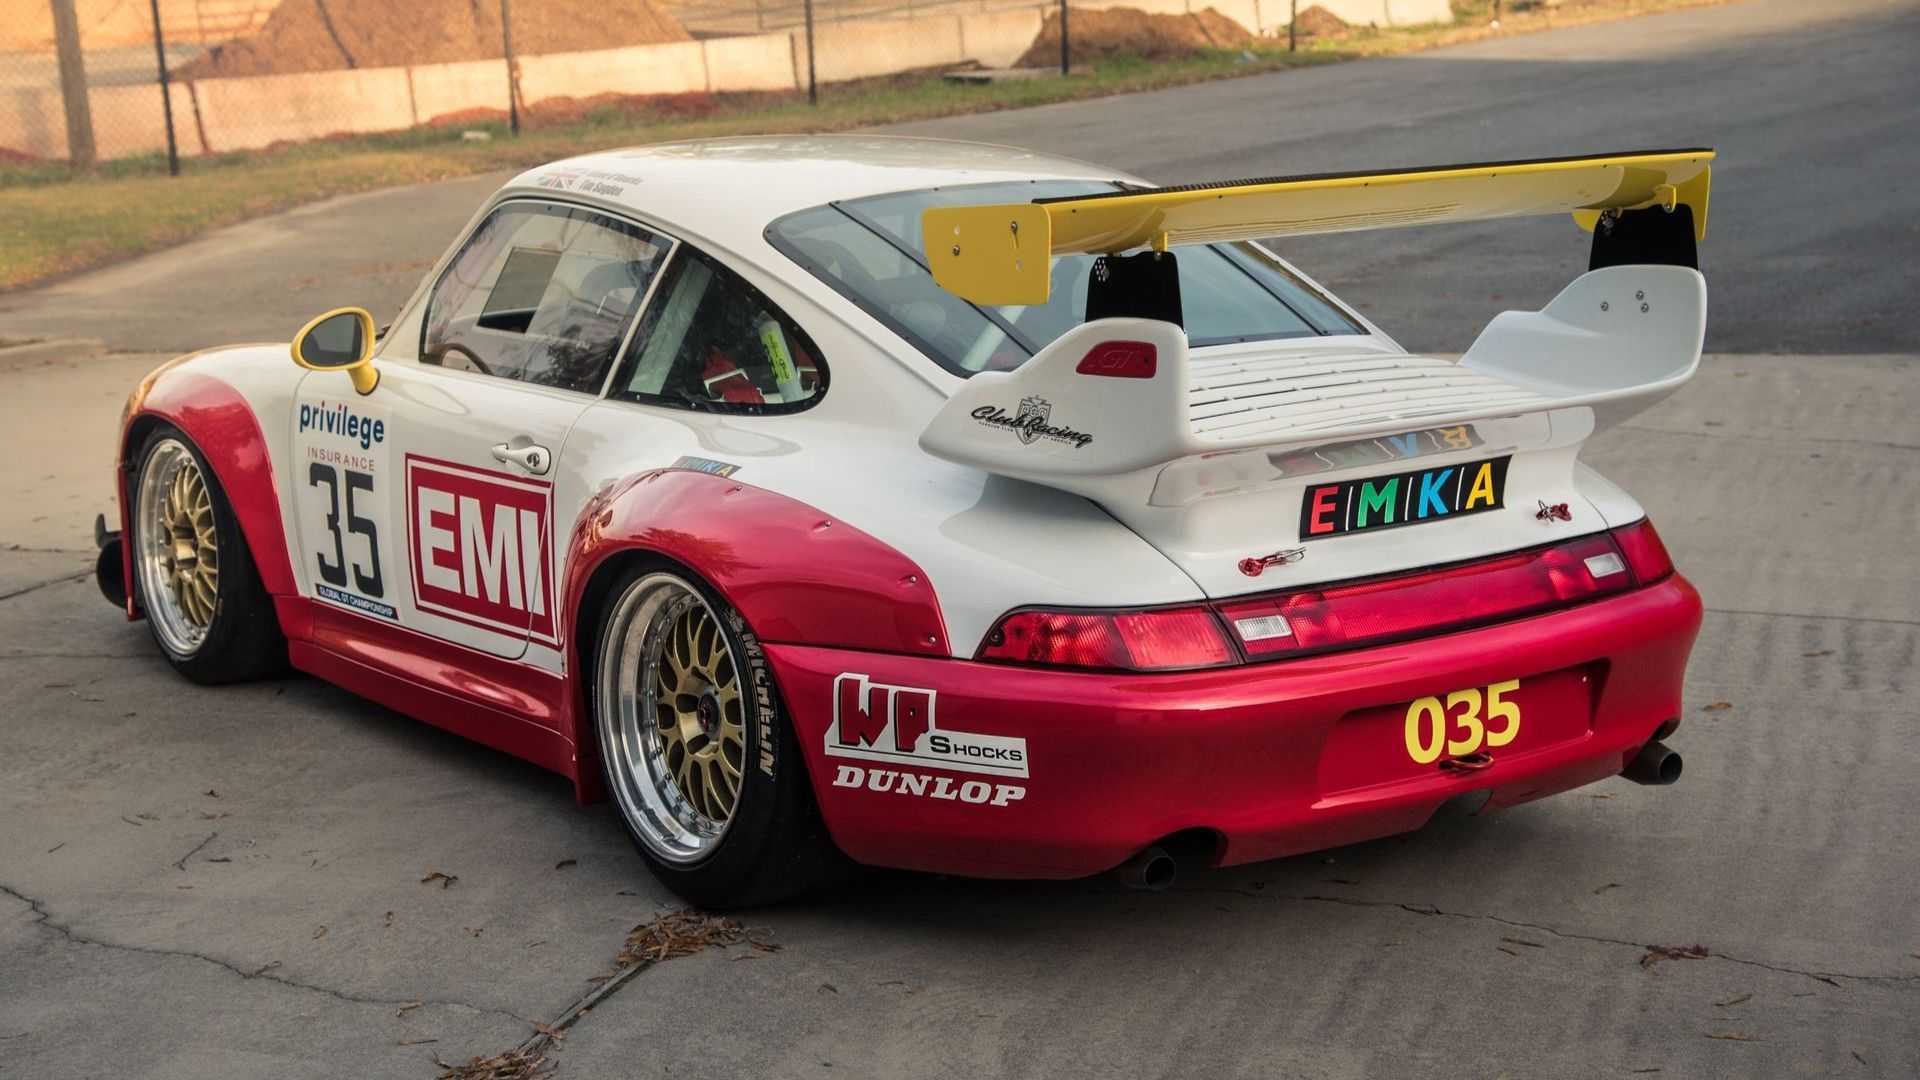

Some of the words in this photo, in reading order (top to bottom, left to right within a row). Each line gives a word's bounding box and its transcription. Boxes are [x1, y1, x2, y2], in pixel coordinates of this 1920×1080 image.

[299, 400, 385, 450] privilege
[307, 446, 376, 472] INSURANCE
[970, 405, 1028, 429] Club
[1023, 416, 1094, 449] Racing
[309, 461, 384, 598] 35
[417, 485, 546, 617] EMI
[742, 632, 775, 777] MICHELIN
[1404, 678, 1521, 765] 035
[832, 765, 1027, 807] DUNLOP
